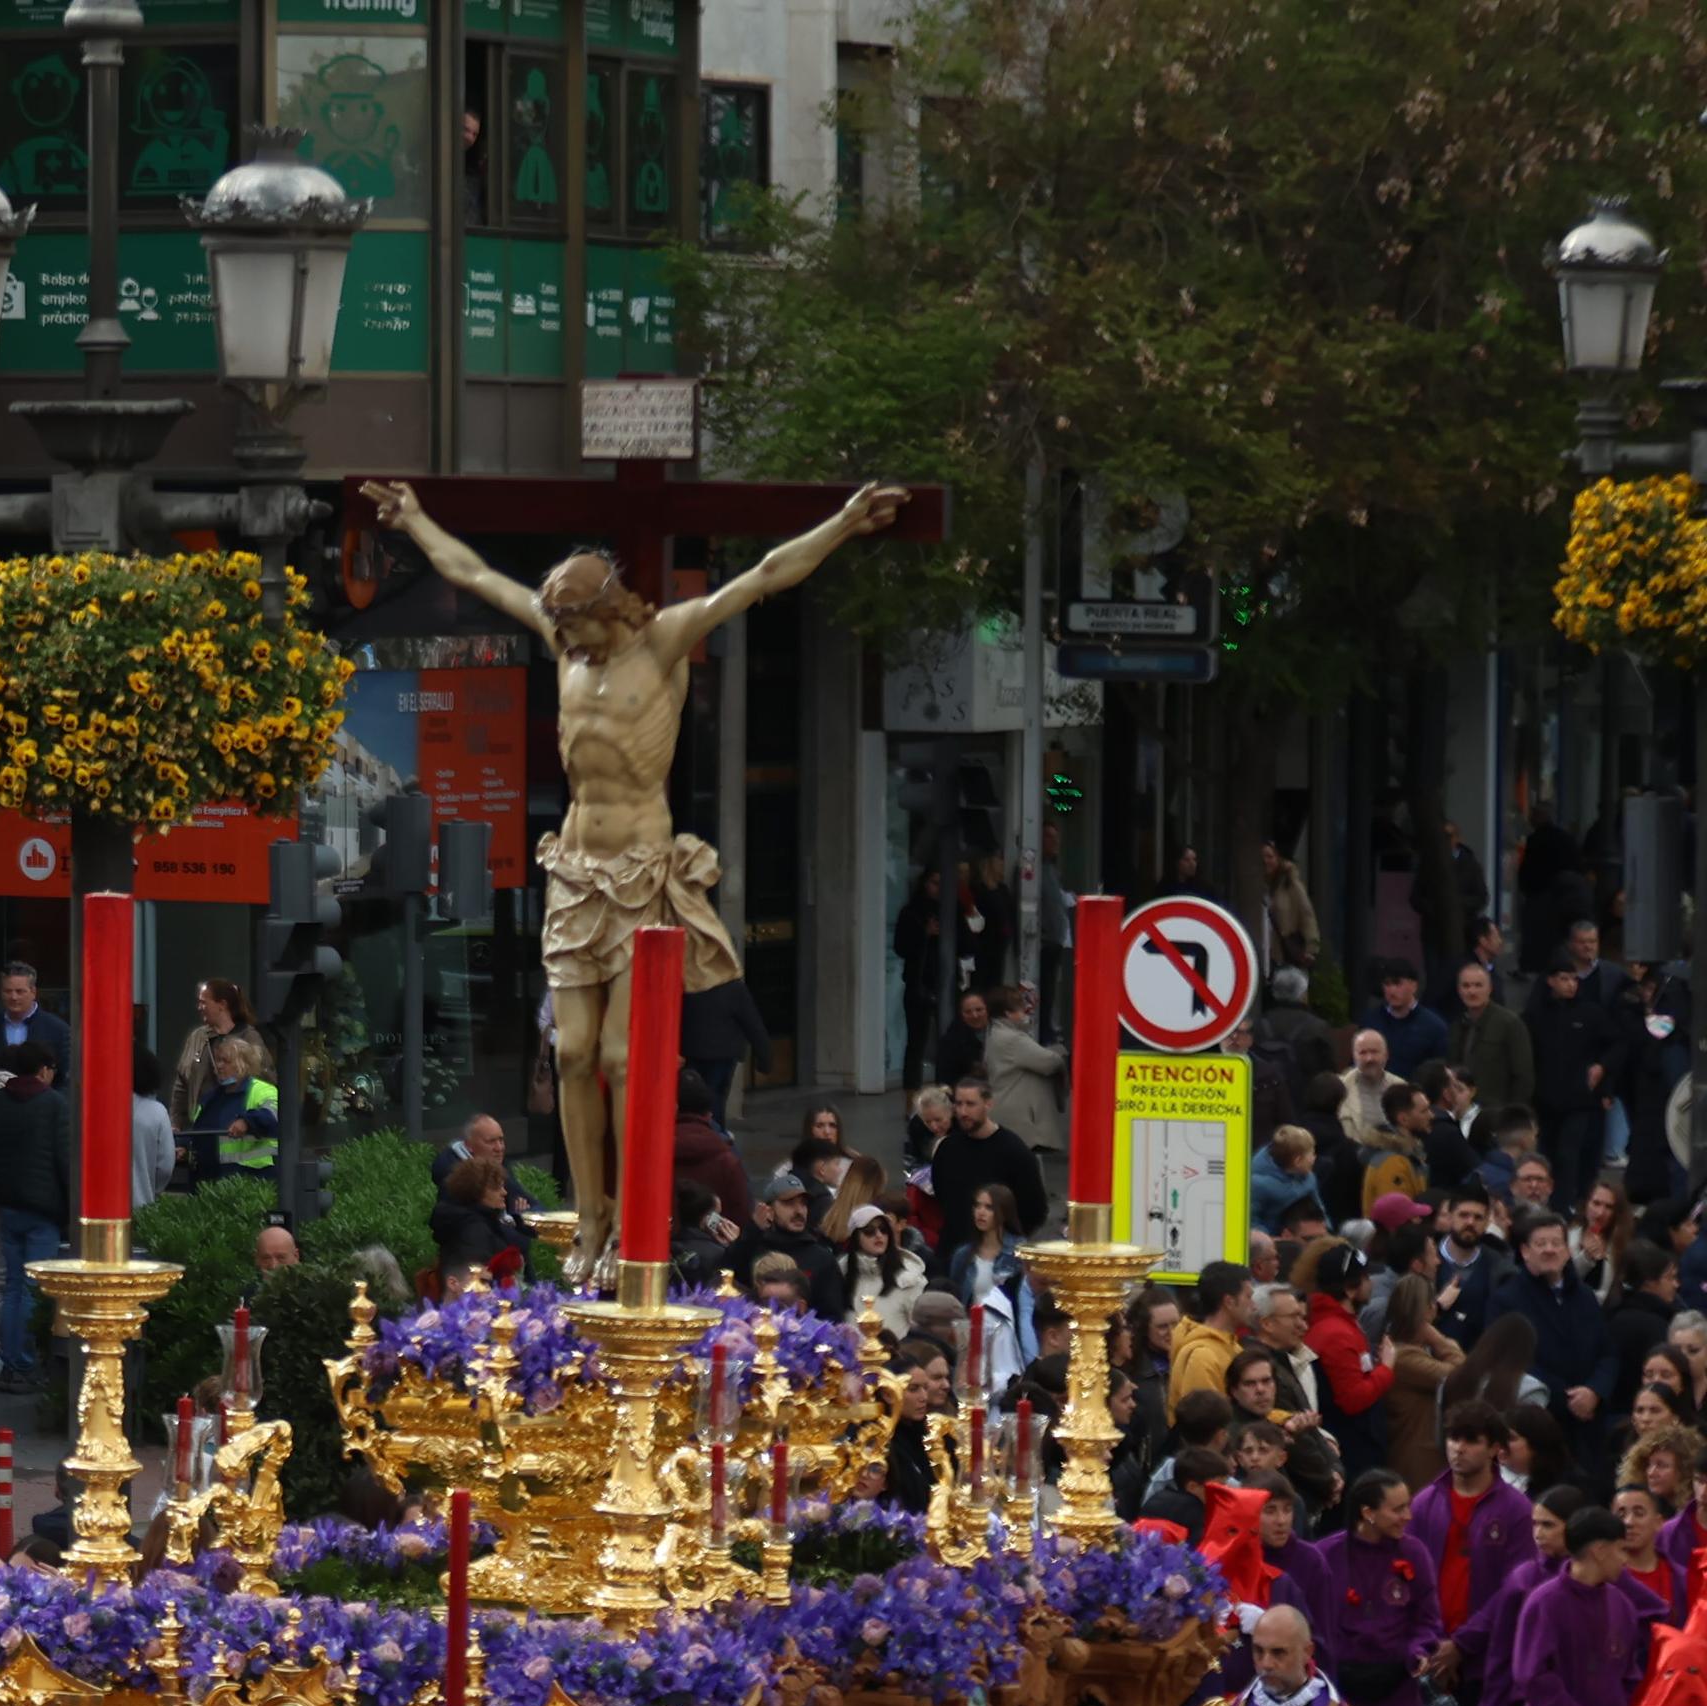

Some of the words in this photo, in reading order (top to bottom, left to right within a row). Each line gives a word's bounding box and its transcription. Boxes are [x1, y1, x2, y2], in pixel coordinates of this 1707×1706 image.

[41, 292, 87, 308] empleo
[1125, 1062, 1235, 1084] ATENCIÓN
[1131, 1084, 1227, 1099] PRECAUCIÓN
[1150, 1102, 1159, 1112] A
[1162, 1102, 1177, 1113] LA
[1181, 1102, 1244, 1117] DERECHA
